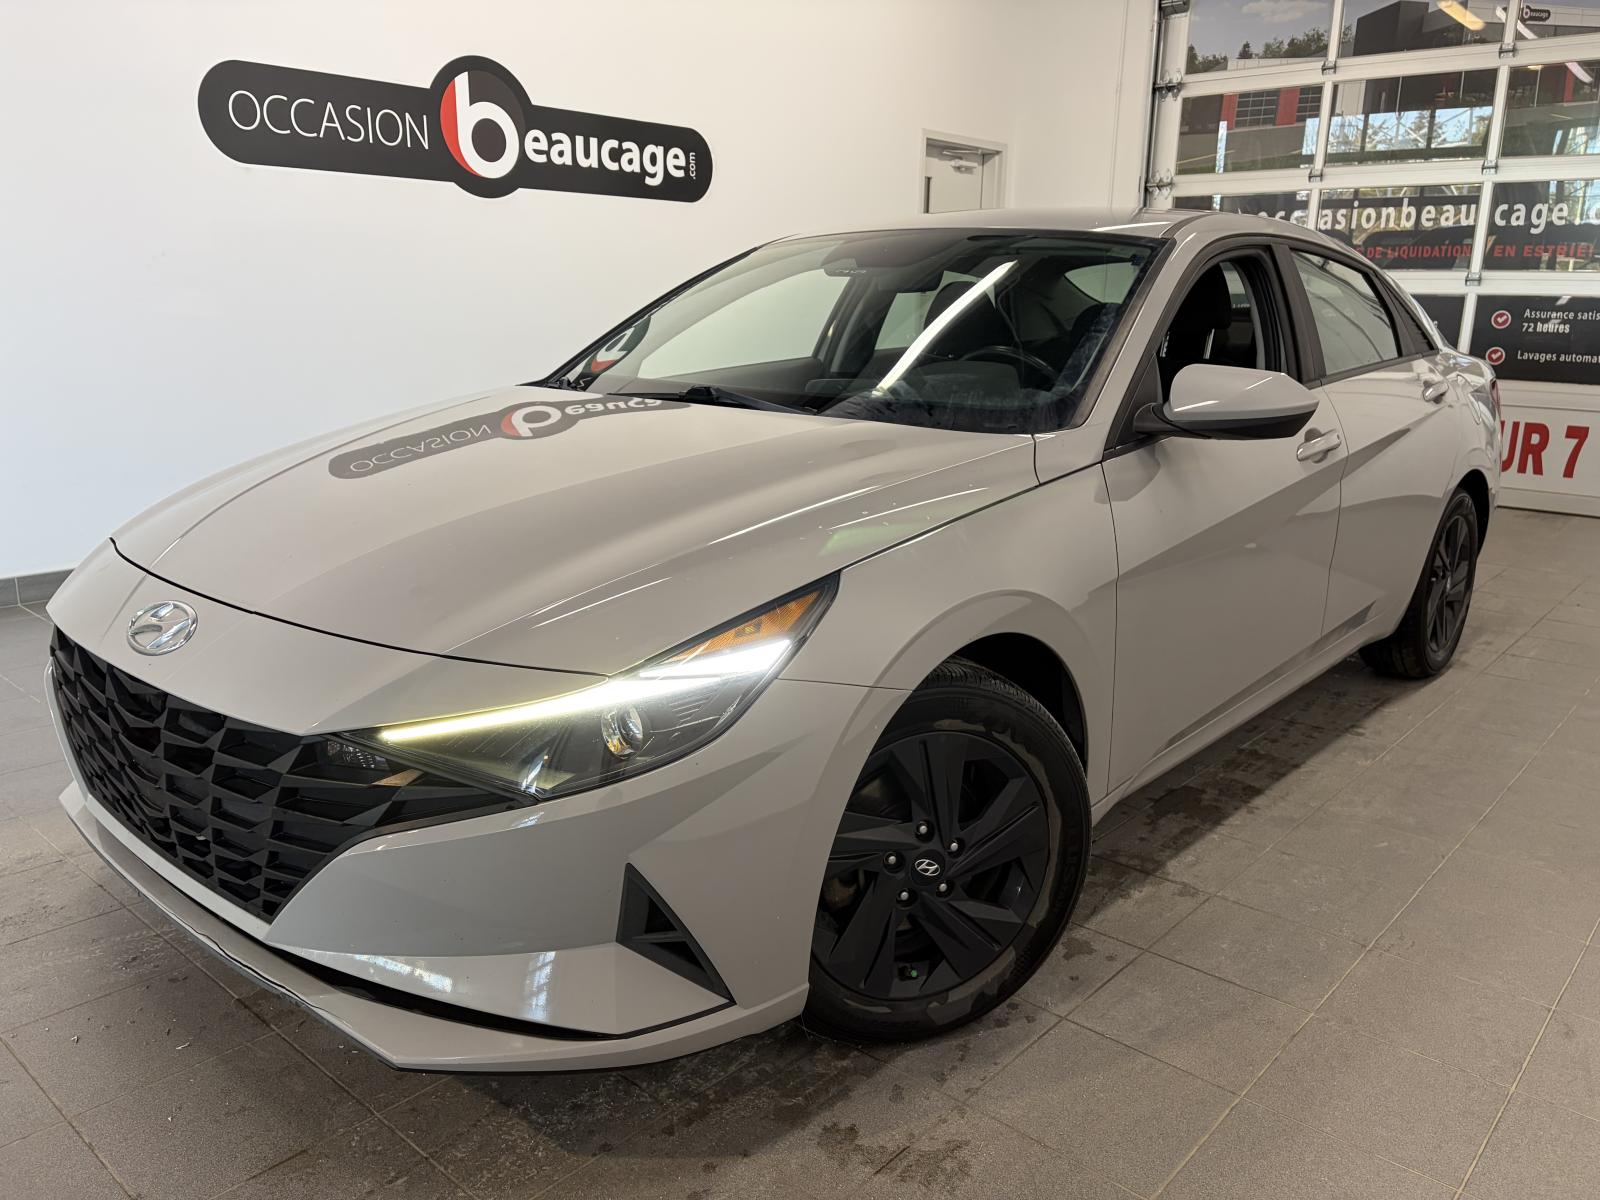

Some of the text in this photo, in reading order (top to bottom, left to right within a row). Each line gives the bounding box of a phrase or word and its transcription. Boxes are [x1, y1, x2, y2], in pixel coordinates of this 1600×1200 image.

[228, 90, 429, 150] OCCASION
[1367, 247, 1386, 258] DE
[1493, 245, 1516, 257] EN
[1523, 308, 1575, 320] Assurance
[1522, 321, 1570, 334] 72 heures
[1517, 350, 1557, 363] Lavages
[1562, 425, 1590, 479] 7
